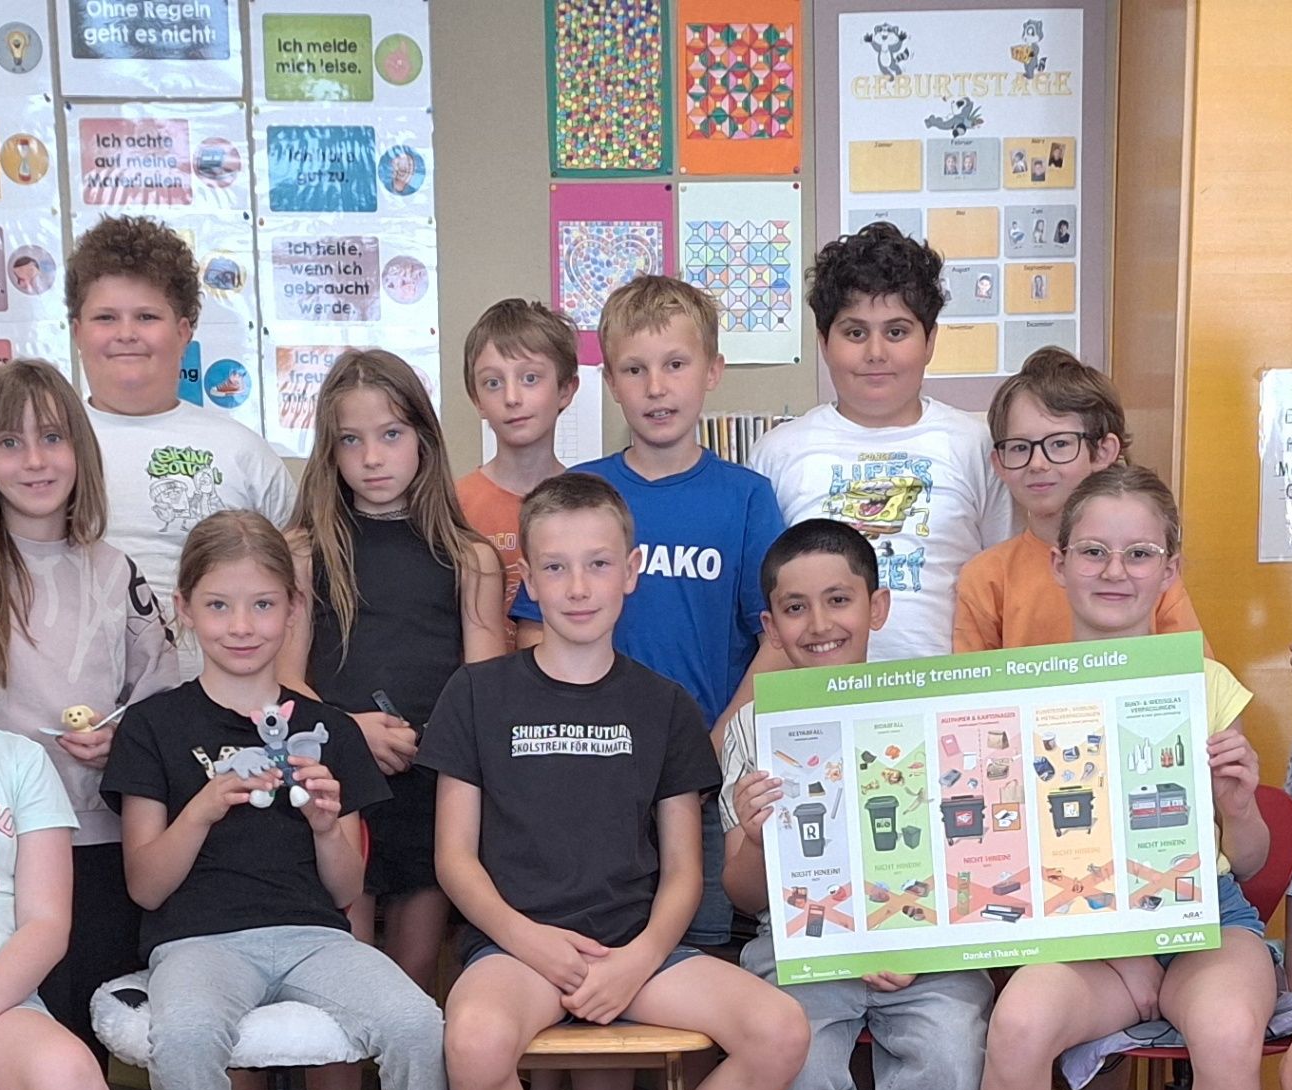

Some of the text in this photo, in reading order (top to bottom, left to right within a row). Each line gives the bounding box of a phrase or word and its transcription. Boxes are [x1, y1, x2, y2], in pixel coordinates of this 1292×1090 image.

[86, 0, 210, 22] Ohne Regeln
[84, 26, 129, 45] geht
[136, 29, 157, 43] es
[277, 38, 358, 53] Ich melde
[276, 59, 316, 74] mich
[851, 71, 1073, 99] GEBURTSTAGE
[97, 134, 173, 149] Ich achte
[95, 154, 177, 168] auf meine
[289, 242, 362, 258] Ich helfe,
[291, 262, 363, 275] wenn ich
[284, 282, 369, 298] gebraucht
[299, 302, 356, 315] werde.
[637, 544, 722, 580] JAKO
[826, 651, 1128, 692] Abfall richtig trennen Recycling Guide
[512, 725, 557, 740] SHIRTS
[560, 724, 583, 738] FOR
[512, 740, 632, 754] SKOLSTREJK FÖR KLIMATET
[1172, 931, 1206, 944] ATM
[992, 947, 1019, 958] Thank
